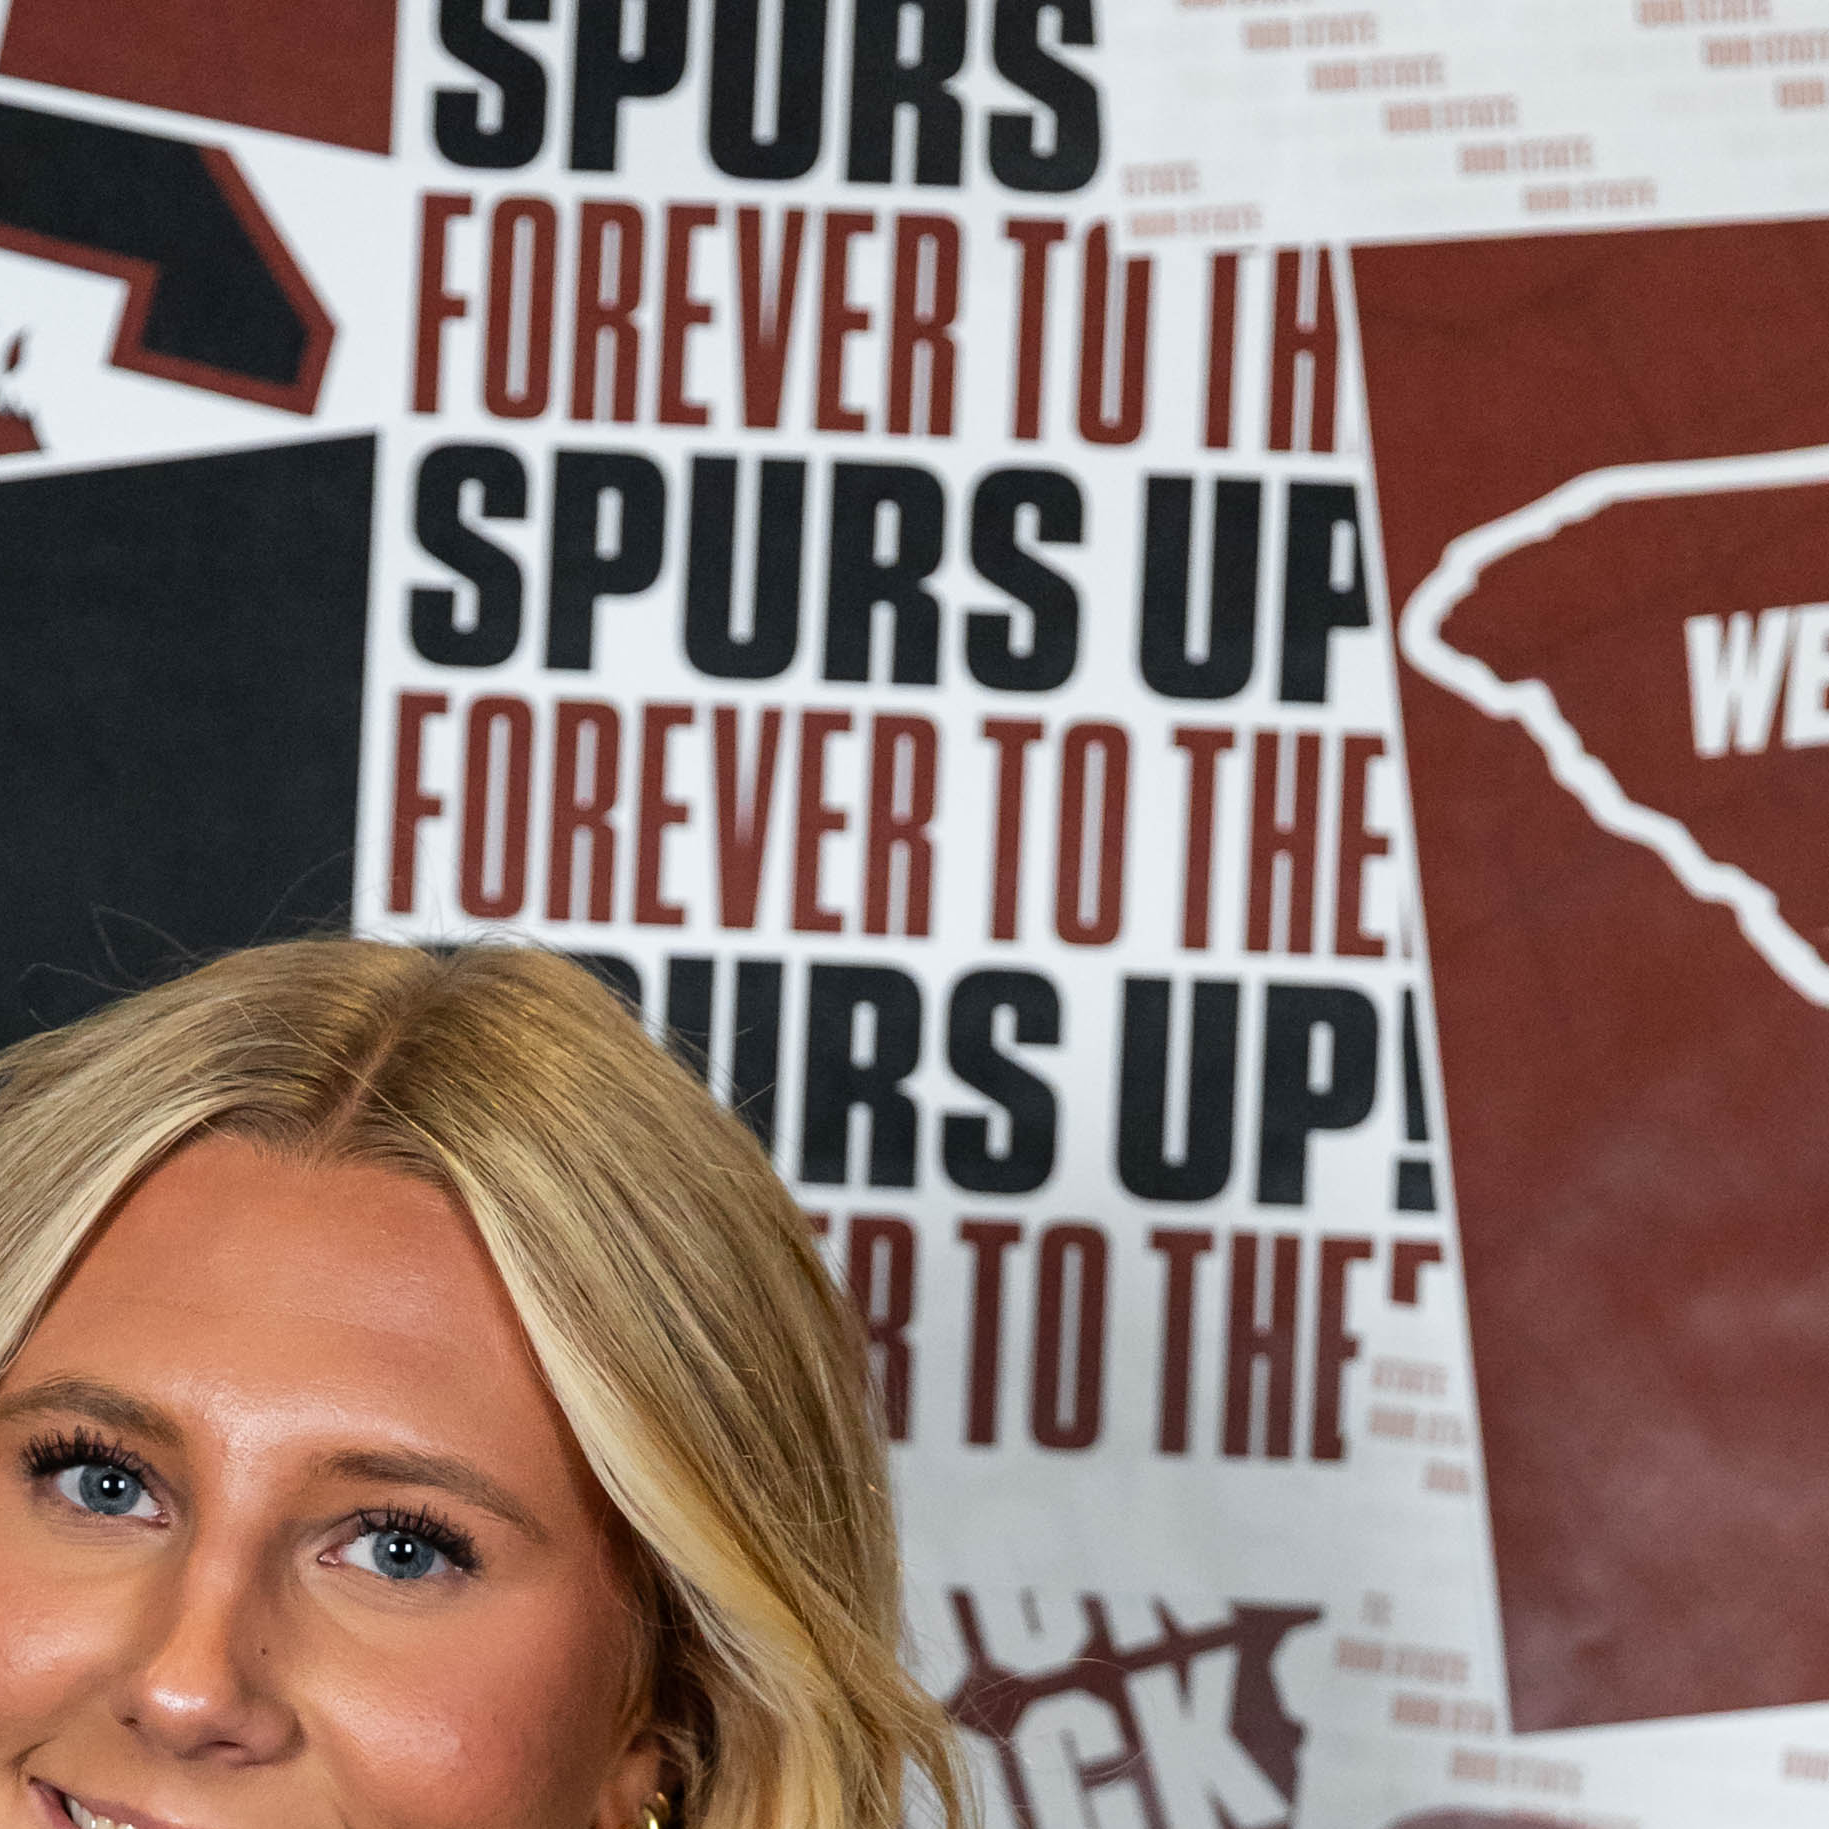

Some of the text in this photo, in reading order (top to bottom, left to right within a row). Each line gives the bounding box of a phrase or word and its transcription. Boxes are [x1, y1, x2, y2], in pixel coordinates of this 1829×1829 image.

[433, 0, 1103, 193] SPURS
[411, 191, 961, 437] FOREVER
[1004, 216, 1155, 446] TO
[408, 442, 1373, 705] SPURS UP
[387, 690, 1389, 957] FOREVER TO THE
[1117, 975, 1438, 1213] UP!
[958, 1218, 1109, 1451] TO
